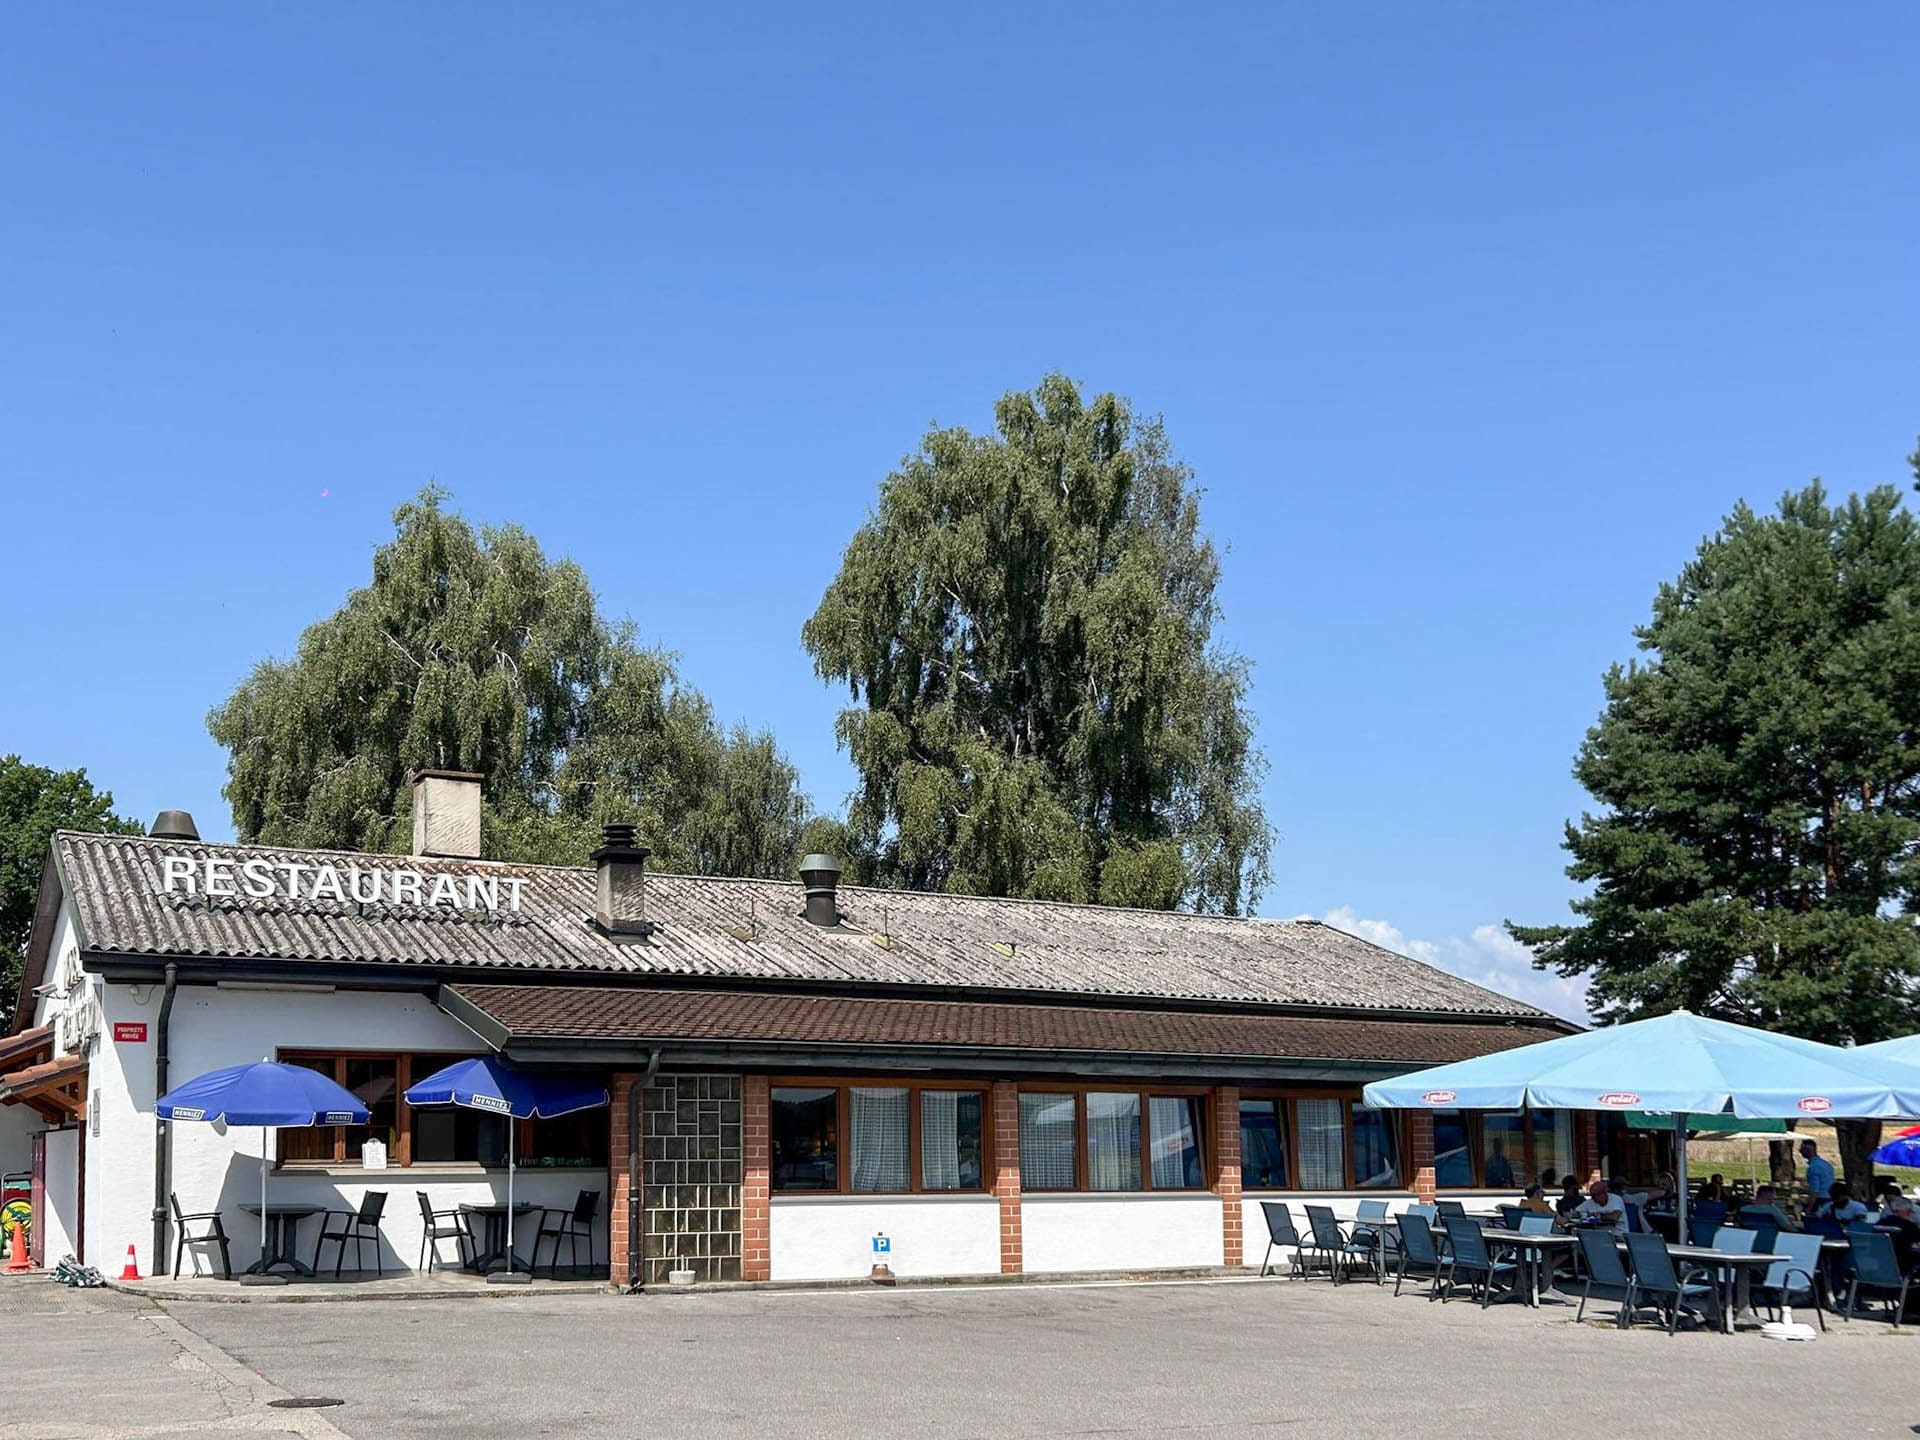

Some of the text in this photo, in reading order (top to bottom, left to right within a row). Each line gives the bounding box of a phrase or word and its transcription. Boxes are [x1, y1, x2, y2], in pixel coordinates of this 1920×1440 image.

[163, 856, 530, 911] RESTAURANT
[474, 1096, 509, 1111] HENNIEZ
[877, 1239, 887, 1251] P
